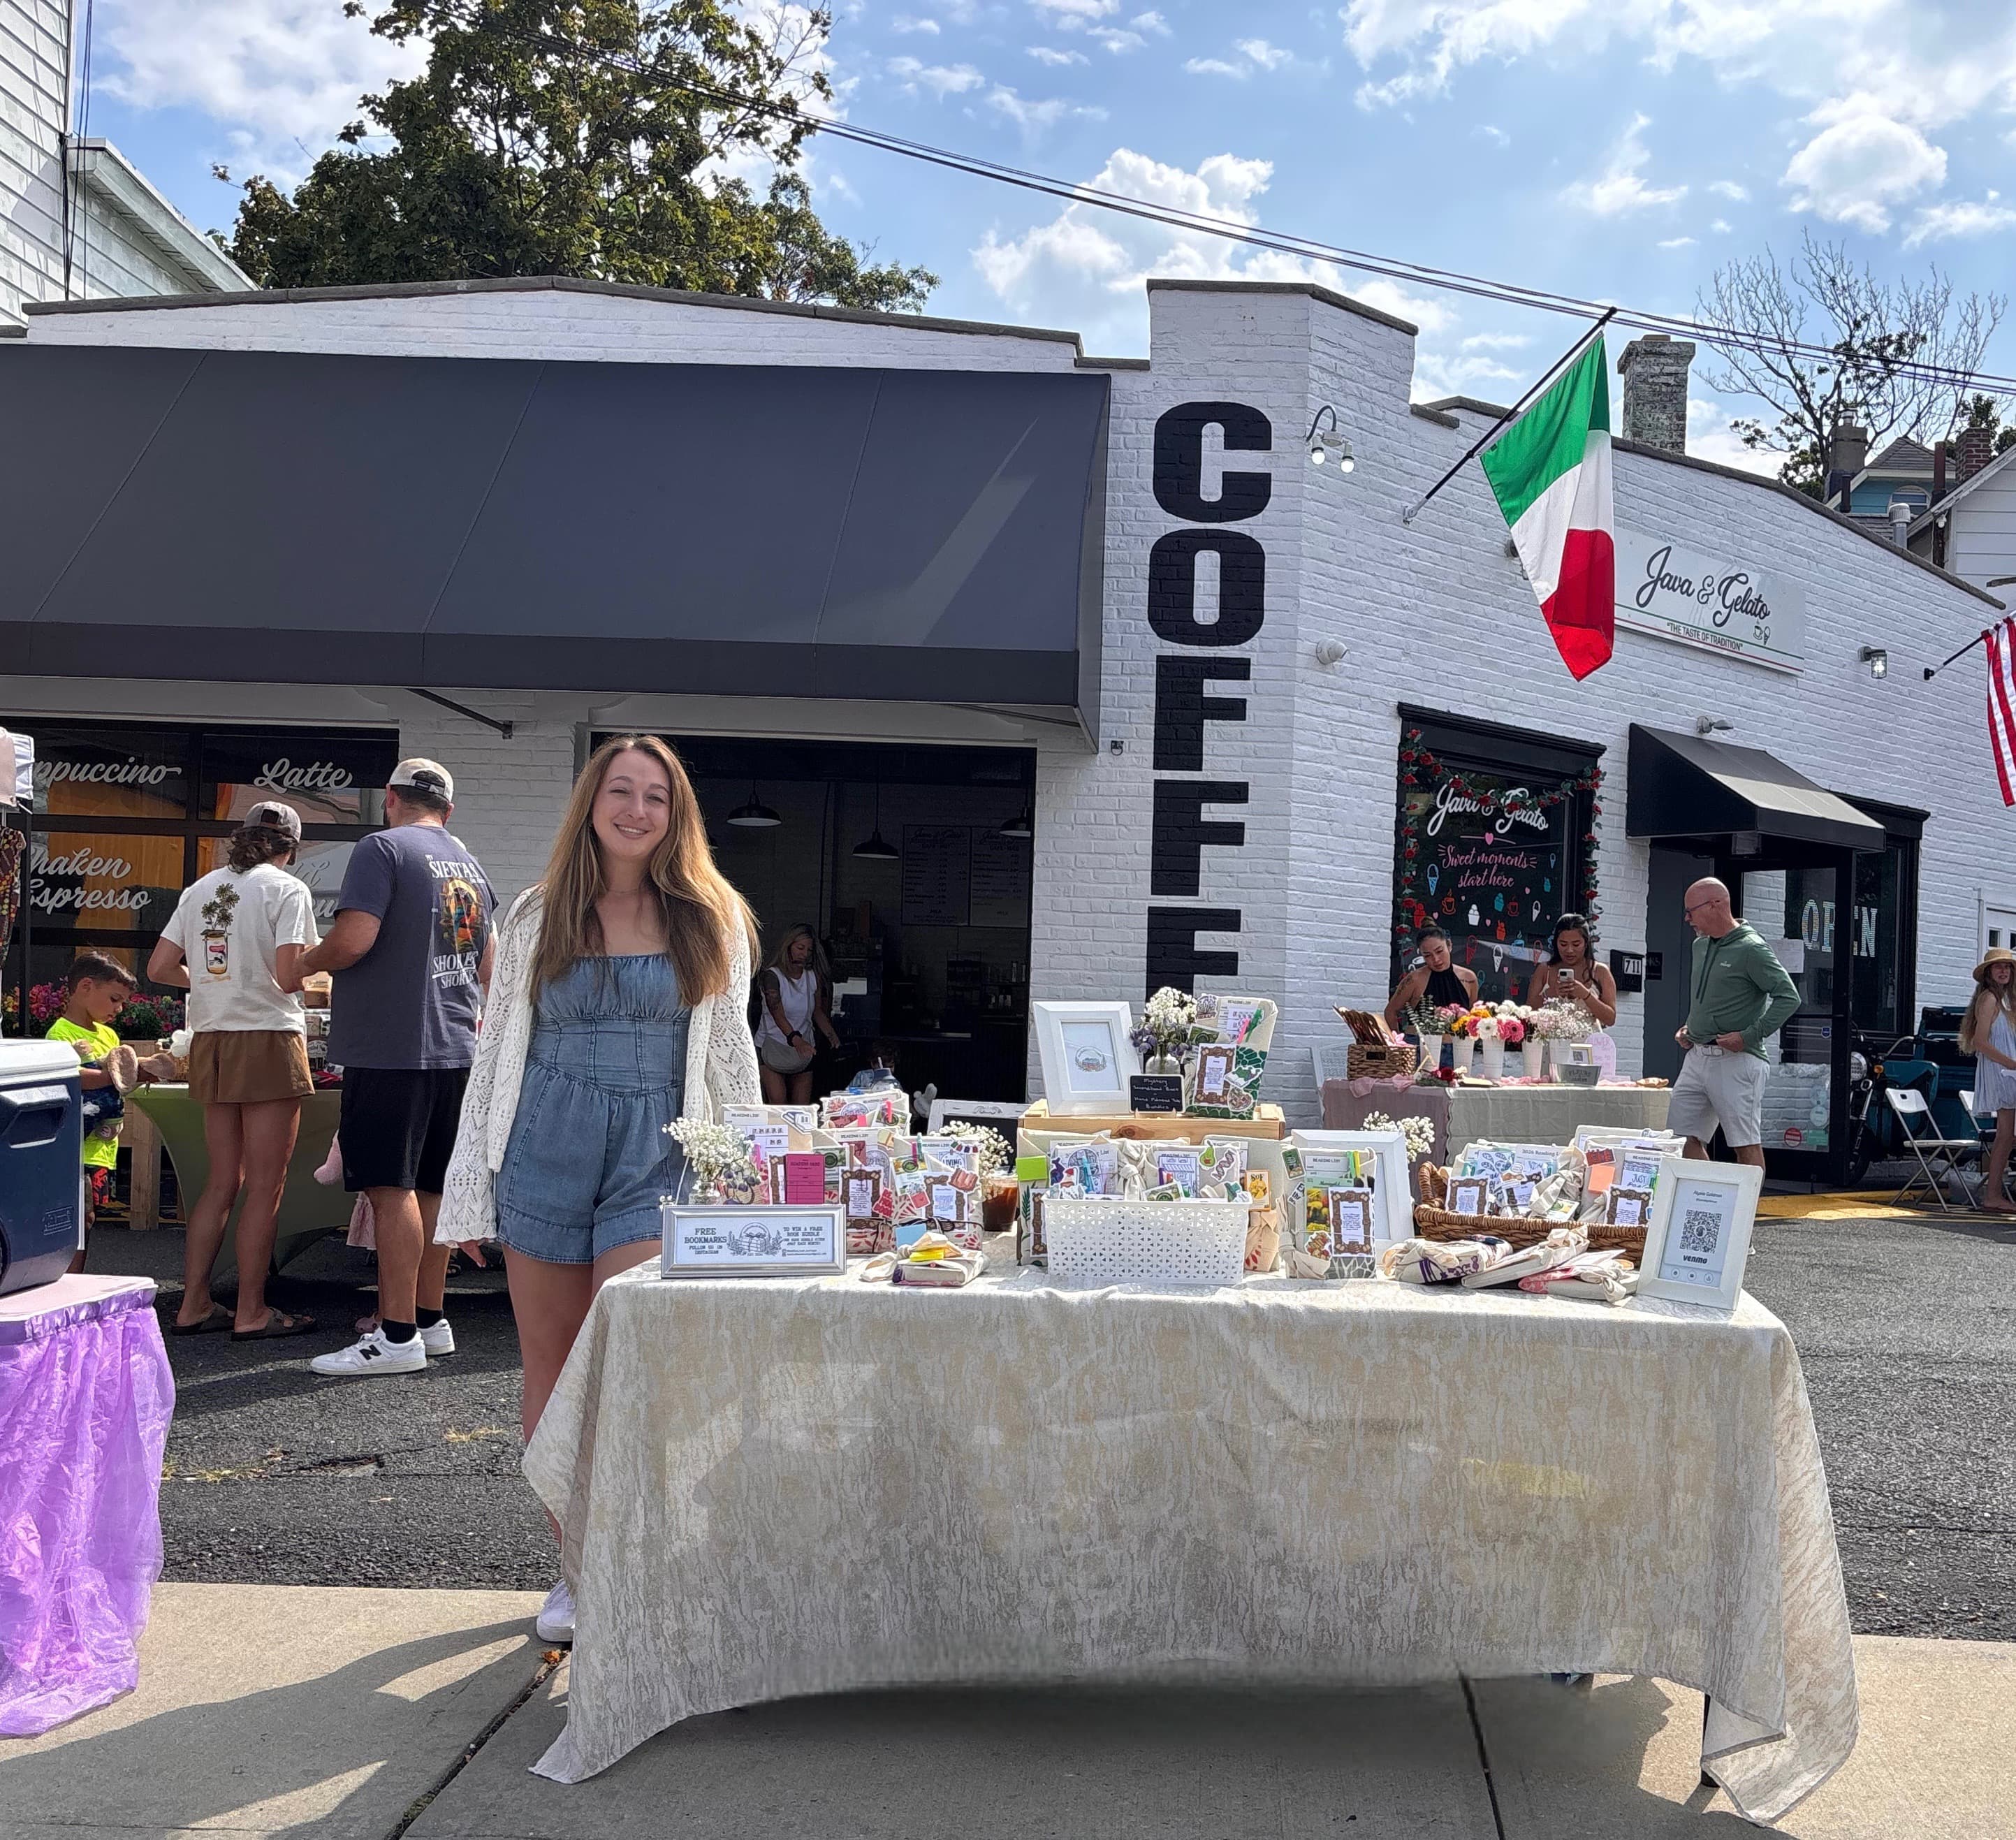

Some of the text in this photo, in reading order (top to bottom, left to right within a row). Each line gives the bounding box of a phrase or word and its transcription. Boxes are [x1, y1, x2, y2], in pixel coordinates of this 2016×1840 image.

[1635, 546, 1771, 627] Java & Gelato
[1682, 627, 1701, 641] TASTE
[1701, 631, 1710, 641] OF
[1146, 401, 1271, 1003] COFFE
[254, 757, 353, 794] Latte
[31, 847, 131, 879] haken
[1442, 845, 1530, 869] Sweet moments
[429, 861, 479, 878] SIESTAS
[1458, 864, 1514, 888] start here
[1625, 959, 1640, 974] 711
[1632, 1174, 1647, 1183] JUST
[1683, 1255, 1708, 1264] venmo
